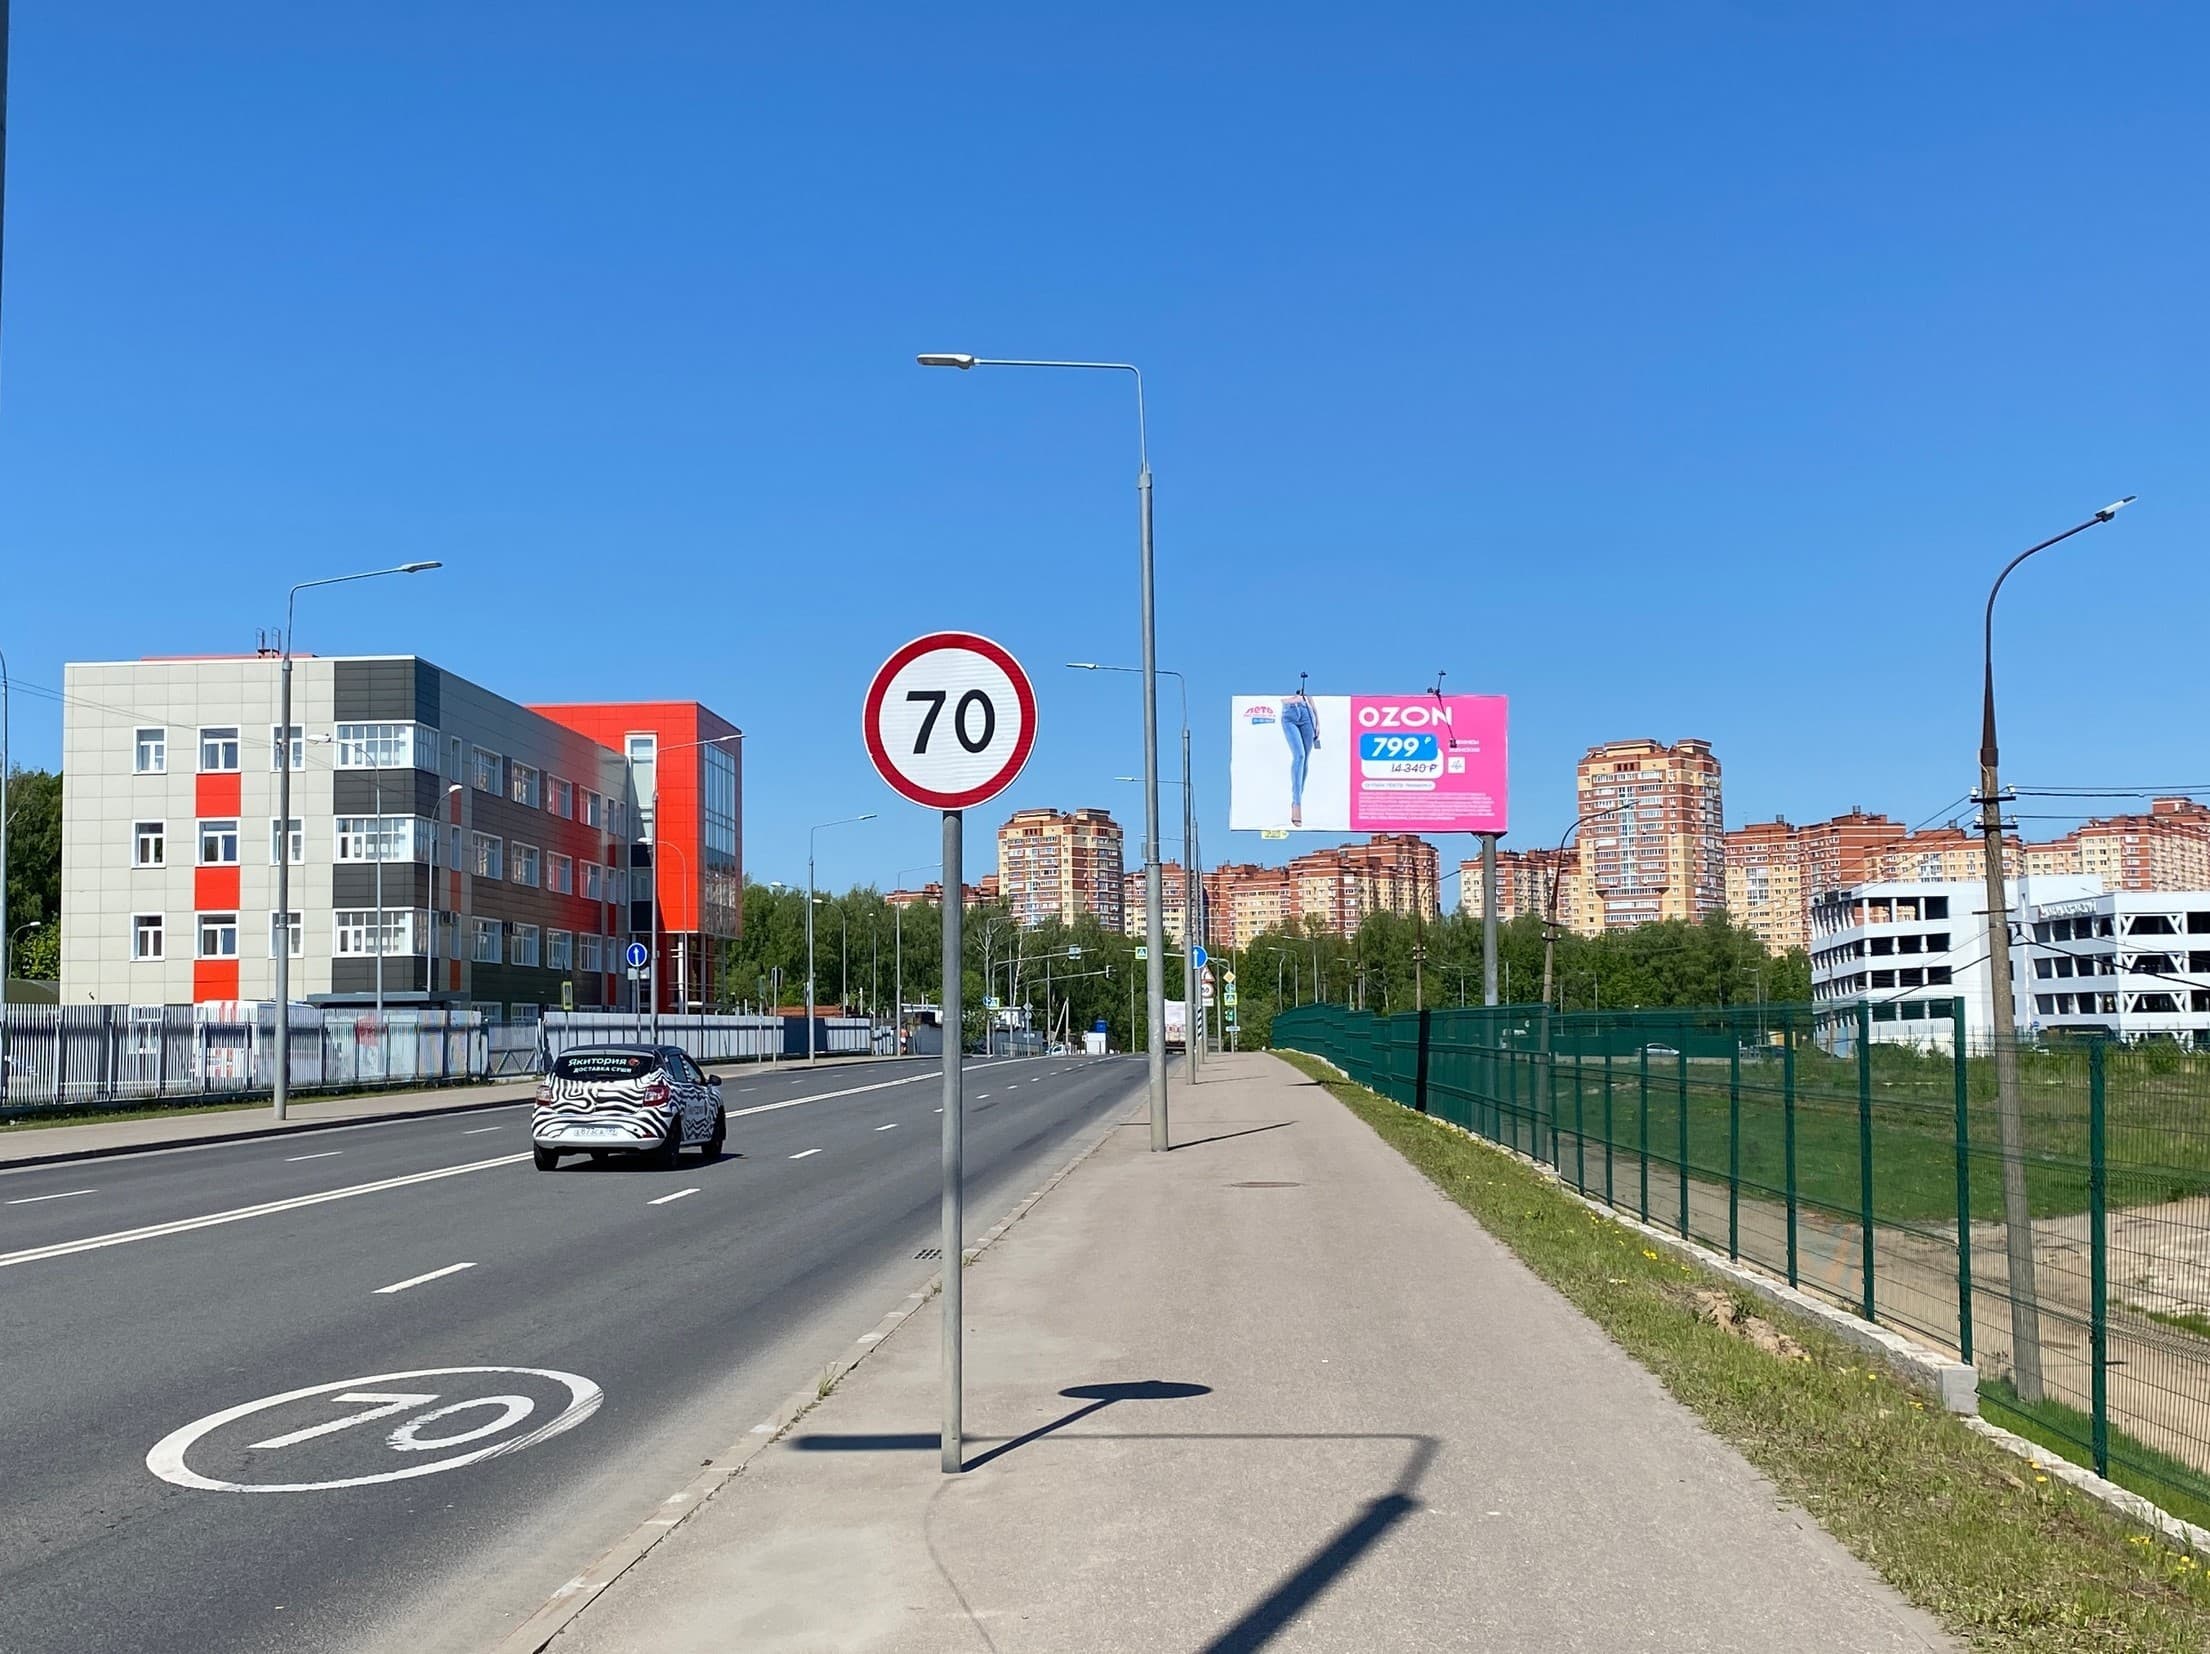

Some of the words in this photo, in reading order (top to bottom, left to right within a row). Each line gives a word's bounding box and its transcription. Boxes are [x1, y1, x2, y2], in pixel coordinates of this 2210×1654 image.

[906, 689, 996, 754] 70
[1358, 706, 1453, 727] OZON
[1371, 737, 1420, 757] 799
[246, 1391, 536, 1452] 70
